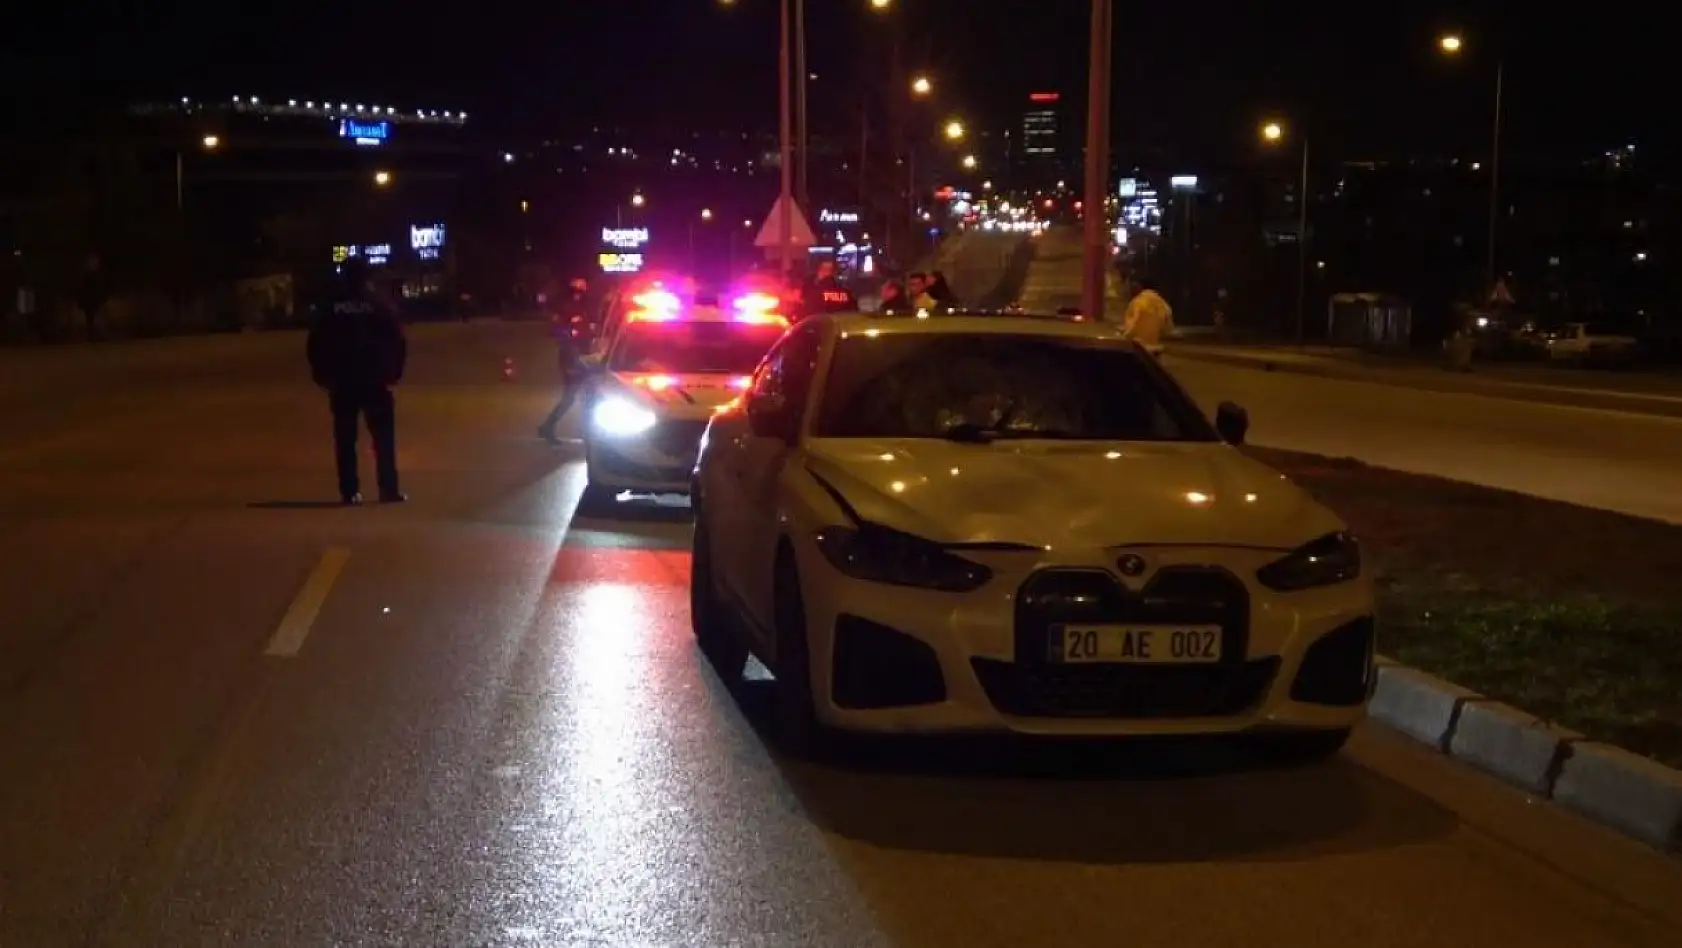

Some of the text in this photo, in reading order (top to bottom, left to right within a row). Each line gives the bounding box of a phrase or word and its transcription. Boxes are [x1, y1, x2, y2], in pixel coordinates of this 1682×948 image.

[1067, 630, 1215, 658] 20 AE 002
